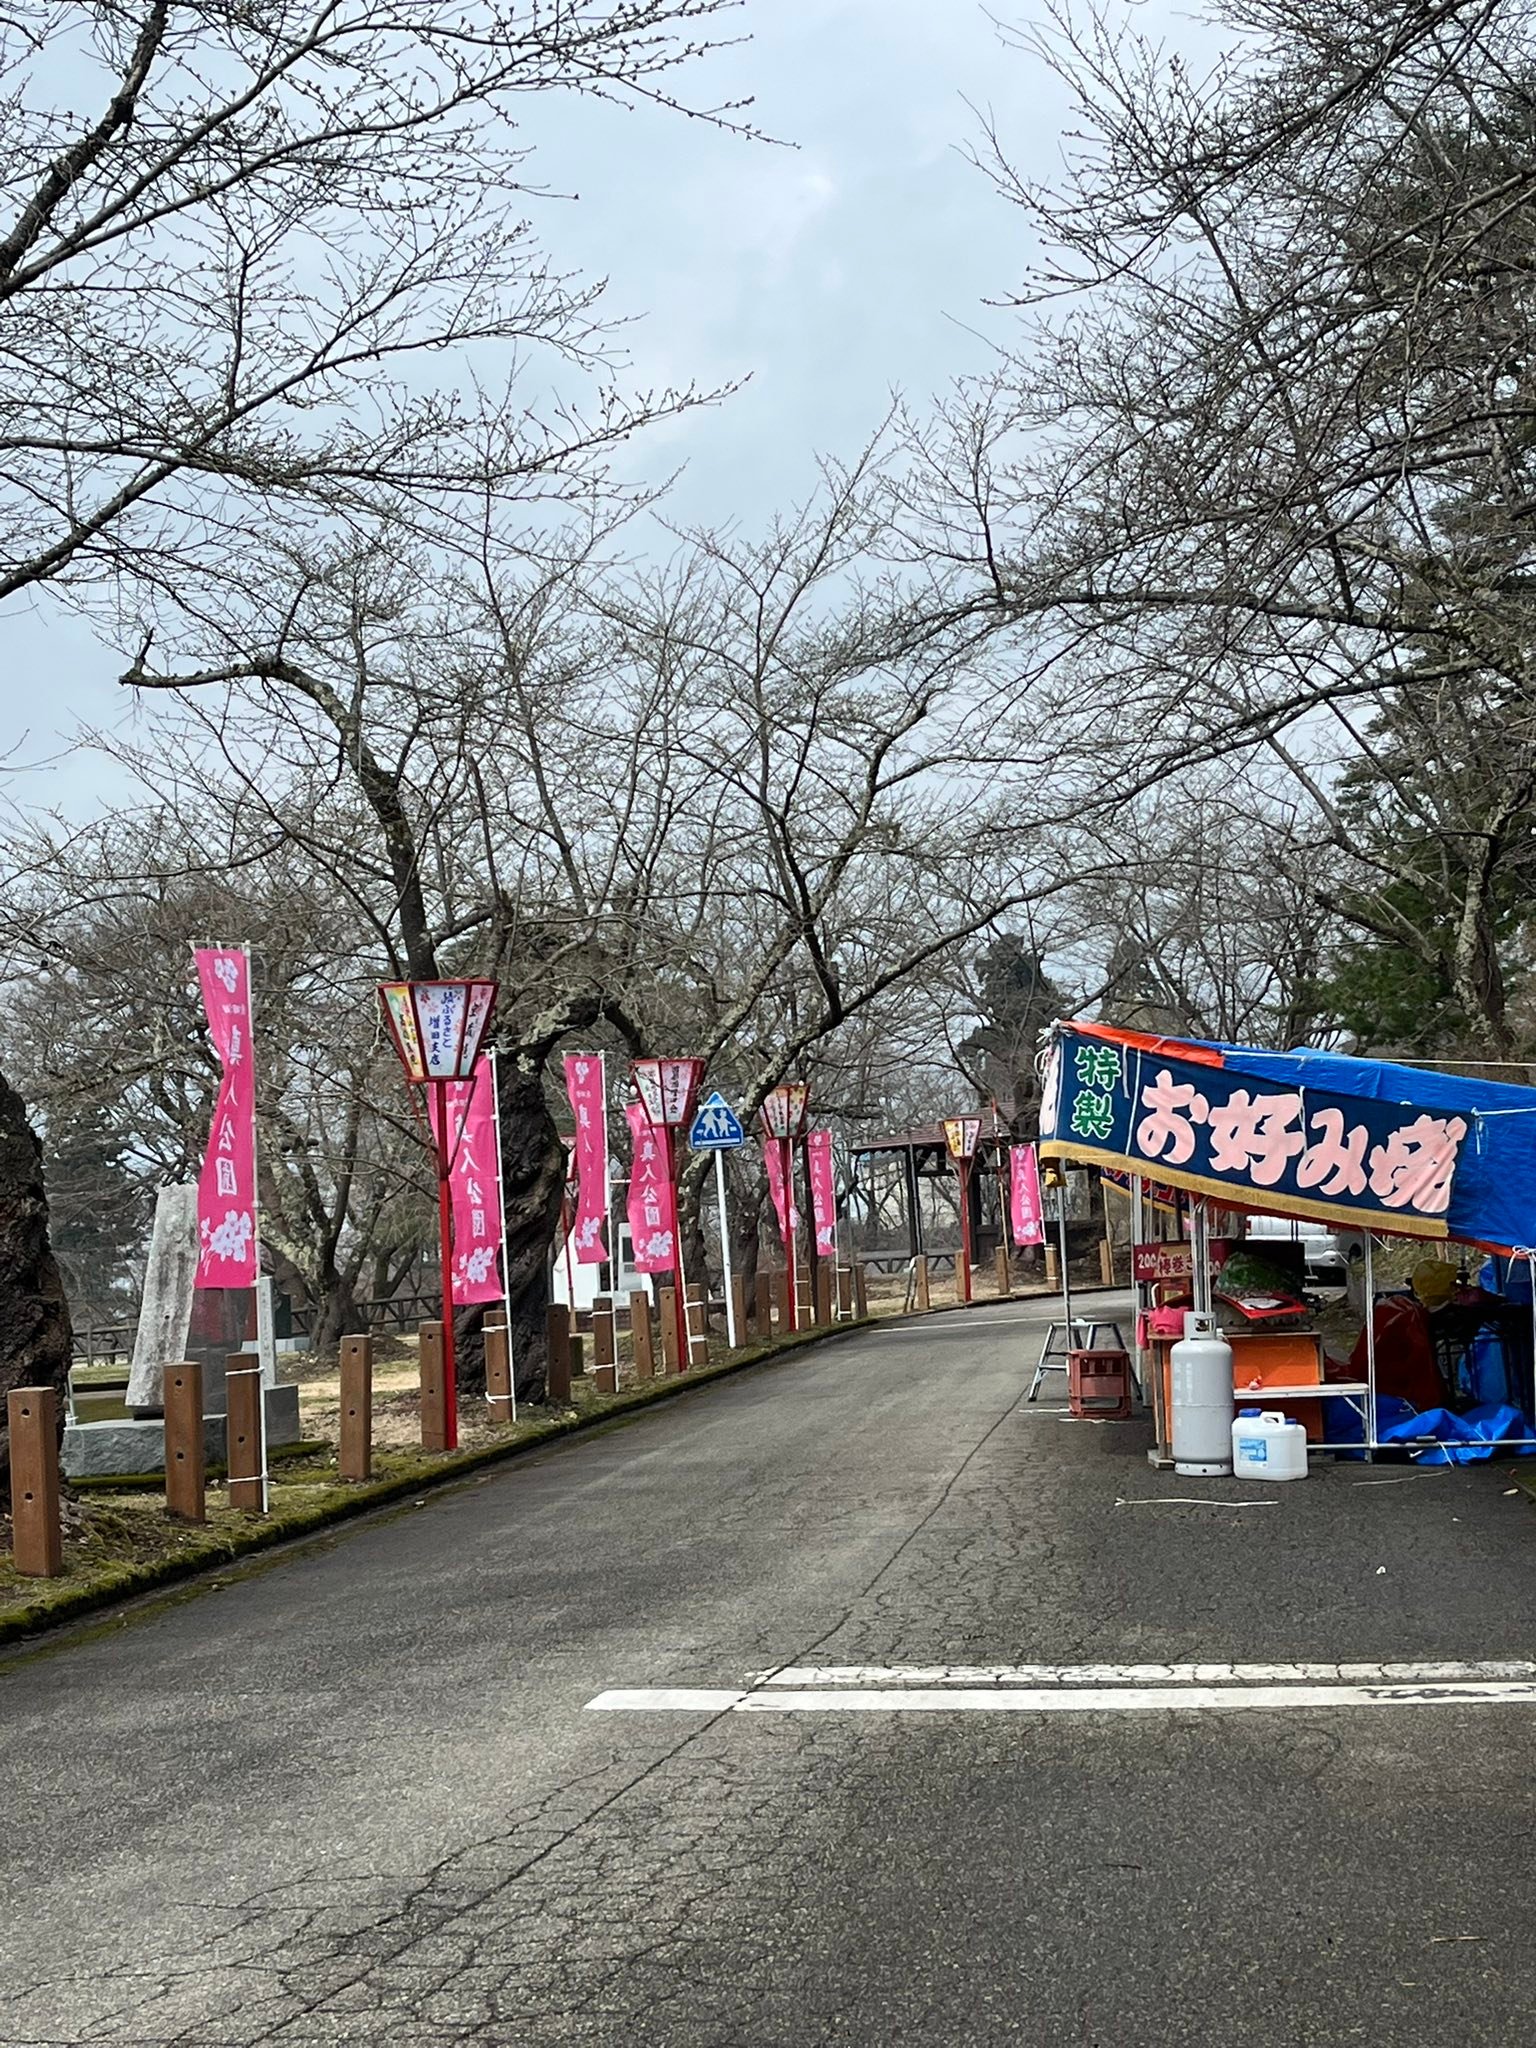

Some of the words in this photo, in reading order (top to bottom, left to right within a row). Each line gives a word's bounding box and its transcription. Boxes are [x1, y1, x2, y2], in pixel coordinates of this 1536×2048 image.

[217, 1024, 241, 1197] 真人公園
[1072, 1045, 1121, 1139] 特製
[1136, 1069, 1467, 1214] お好み焼
[577, 1104, 593, 1209] 真人
[639, 1139, 661, 1227] 真人公園
